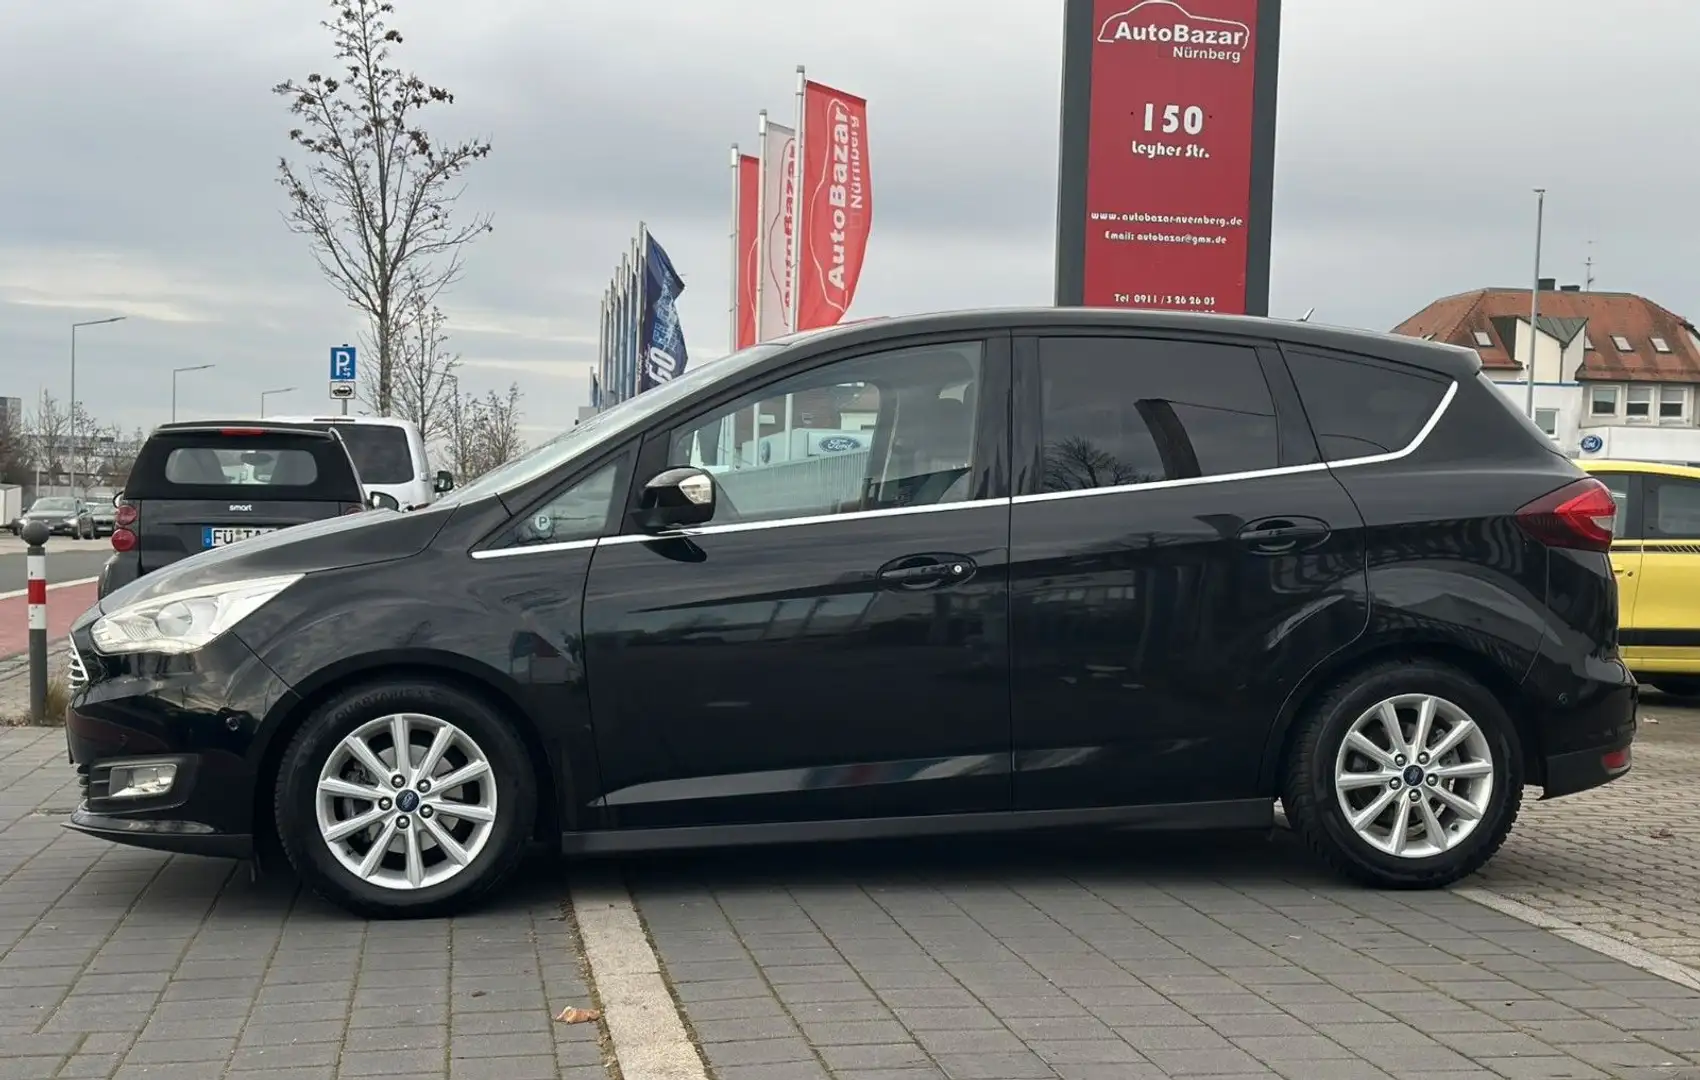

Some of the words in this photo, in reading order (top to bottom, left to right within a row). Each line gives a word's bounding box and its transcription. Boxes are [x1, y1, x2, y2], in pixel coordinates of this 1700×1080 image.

[1114, 21, 1244, 45] AutoBazar
[1173, 46, 1241, 63] Nürnberg
[1144, 103, 1203, 135] 150
[1131, 140, 1182, 159] Leyher
[1185, 143, 1210, 158] Str.
[849, 115, 863, 209] Nürnberg
[828, 107, 850, 290] AutoBazar
[1090, 212, 1244, 227] www.autobazar-nuernberg.de
[1104, 230, 1134, 241] Email:
[1136, 231, 1227, 245] autobazar@gmx.de
[1114, 293, 1129, 302] Tel
[1134, 294, 1157, 303] 0911
[336, 351, 350, 376] P
[213, 529, 234, 544] FÜ
